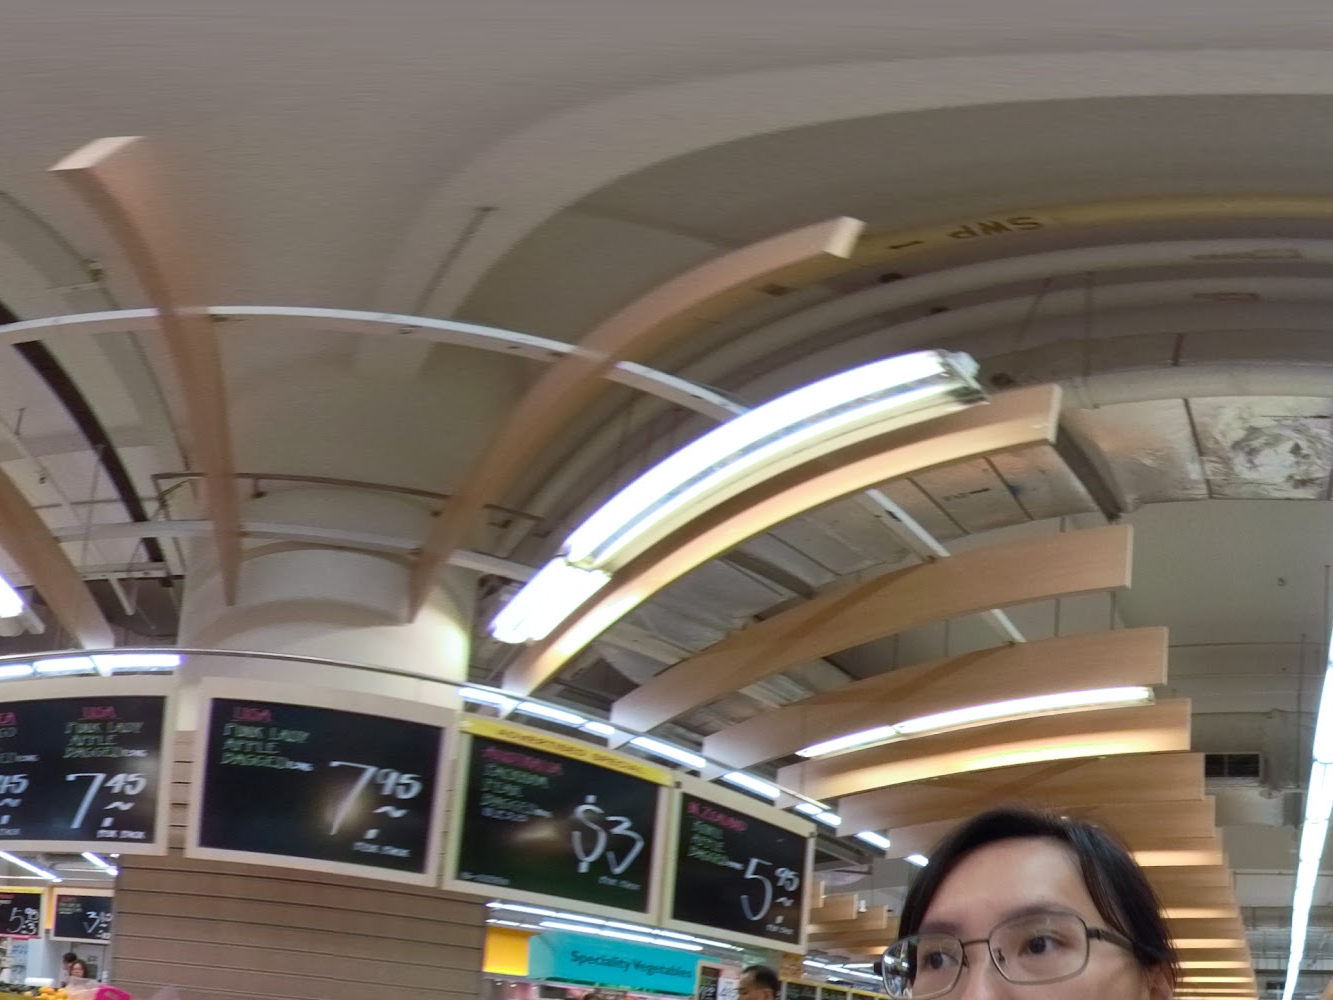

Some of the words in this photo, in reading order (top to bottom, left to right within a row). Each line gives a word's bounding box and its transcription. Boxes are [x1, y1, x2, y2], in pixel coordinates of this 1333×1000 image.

[947, 214, 1045, 241] SWP
[570, 950, 632, 973] Speciality
[633, 960, 693, 979] Vegetables
